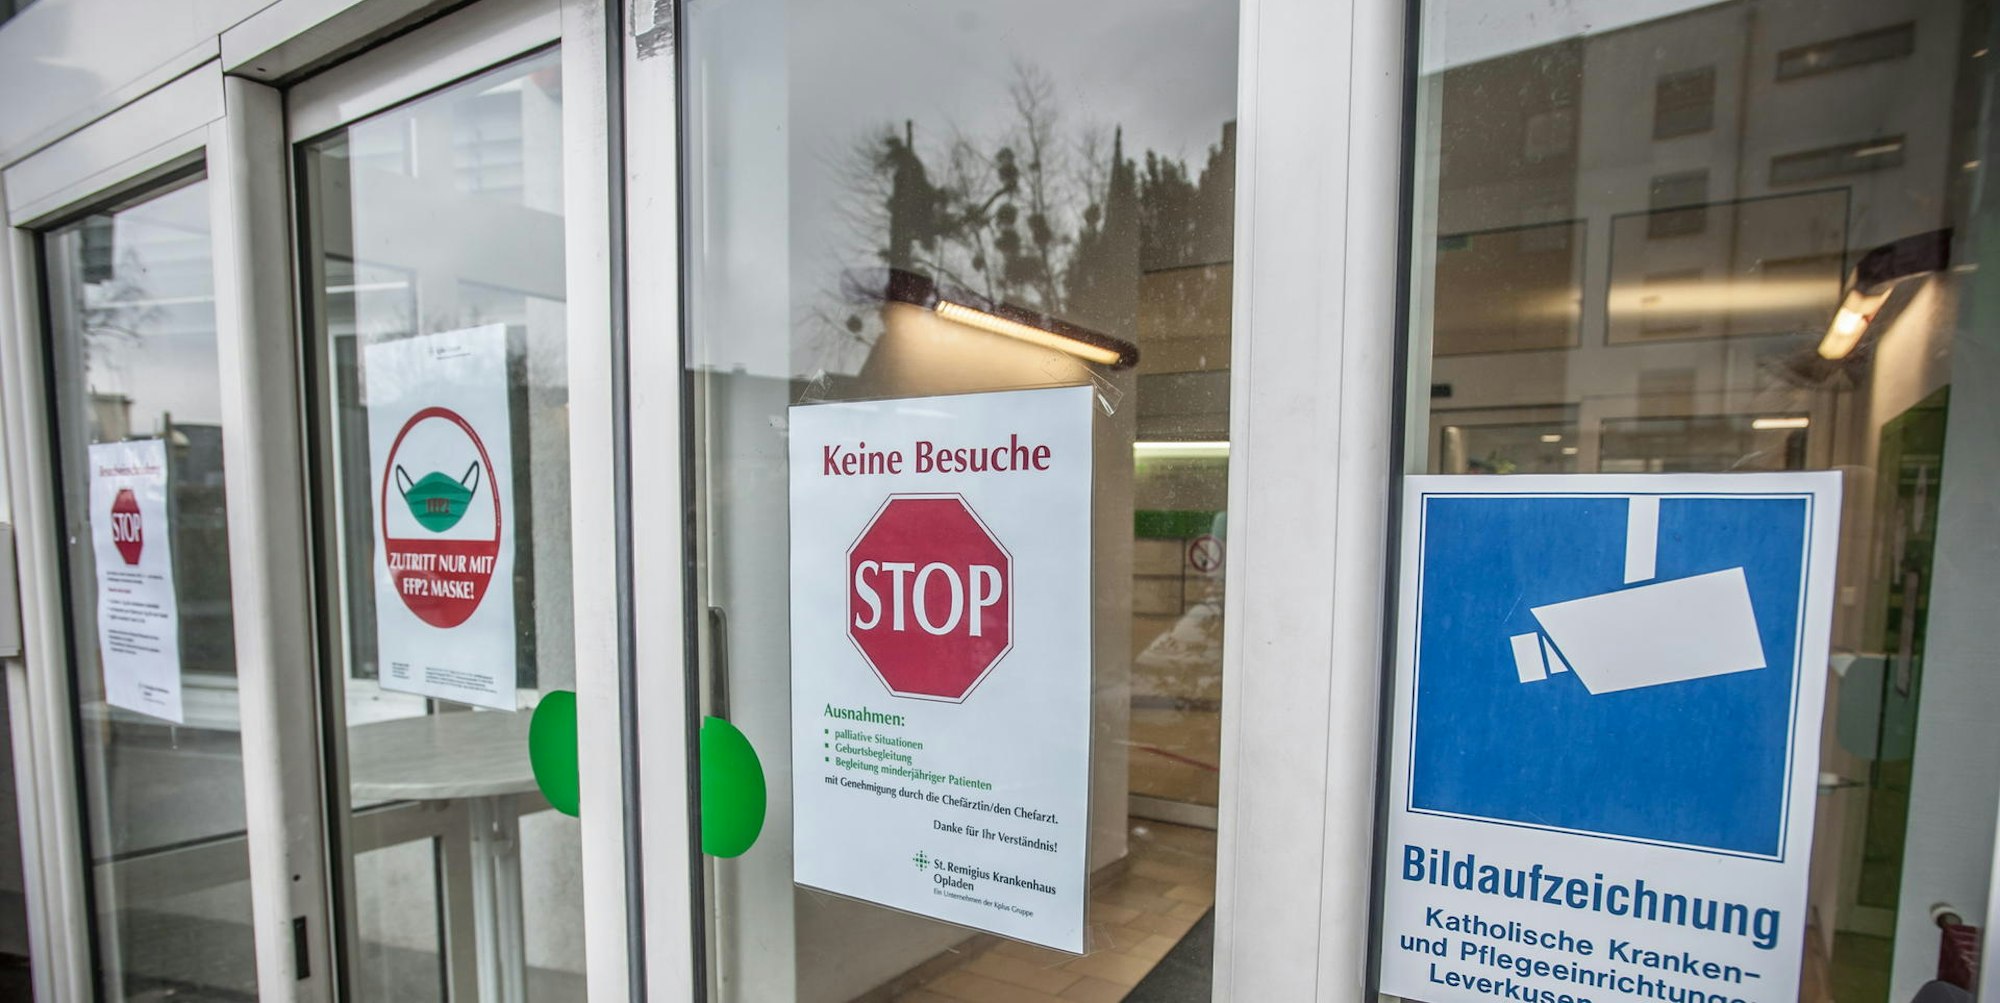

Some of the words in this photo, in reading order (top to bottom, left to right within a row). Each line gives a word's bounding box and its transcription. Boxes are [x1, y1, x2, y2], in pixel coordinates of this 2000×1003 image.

[823, 441, 903, 476] Keine
[915, 433, 1051, 474] Besuche
[426, 497, 450, 515] FFP2
[112, 512, 142, 543] STOP
[389, 552, 437, 571] ZUTRITT
[439, 554, 467, 573] NUR
[469, 556, 494, 574] MIT
[403, 577, 429, 596] FFP2
[431, 580, 475, 599] MASKE!
[855, 559, 1003, 637] STOP
[824, 702, 905, 727] Ausnahmen:
[834, 729, 873, 743] palliative
[875, 734, 924, 750] Situationen
[835, 743, 913, 766] Geburtsbegleitung
[835, 756, 879, 776] Begleitung
[881, 765, 946, 784] minderjähriger
[948, 774, 993, 791] Patienten
[825, 775, 838, 785] mit
[840, 776, 897, 798] Genehmigung
[898, 787, 924, 801] durch
[926, 791, 940, 804] die
[942, 794, 1012, 816] Chefärztin/den
[1014, 806, 1059, 824] Chefarzt.
[933, 819, 963, 834] Danke
[965, 825, 979, 837] für
[982, 828, 996, 841] Ihr
[998, 831, 1058, 853] Verständnis!
[933, 873, 974, 891] Opladen
[934, 858, 946, 871] St.
[947, 861, 990, 880] Remigius
[992, 871, 1057, 895] Krankenhaus
[933, 887, 942, 896] Ein
[943, 889, 982, 905] Unternehmen
[983, 899, 993, 907] der
[1011, 905, 1034, 917] Gruppe
[1402, 844, 1780, 950] Bildaufzeichnung
[1425, 906, 1594, 956] Katholische
[1608, 939, 1761, 984] Kranken-
[1400, 934, 1448, 958] und
[1460, 940, 1757, 1003] Pflegeeinrichtun
